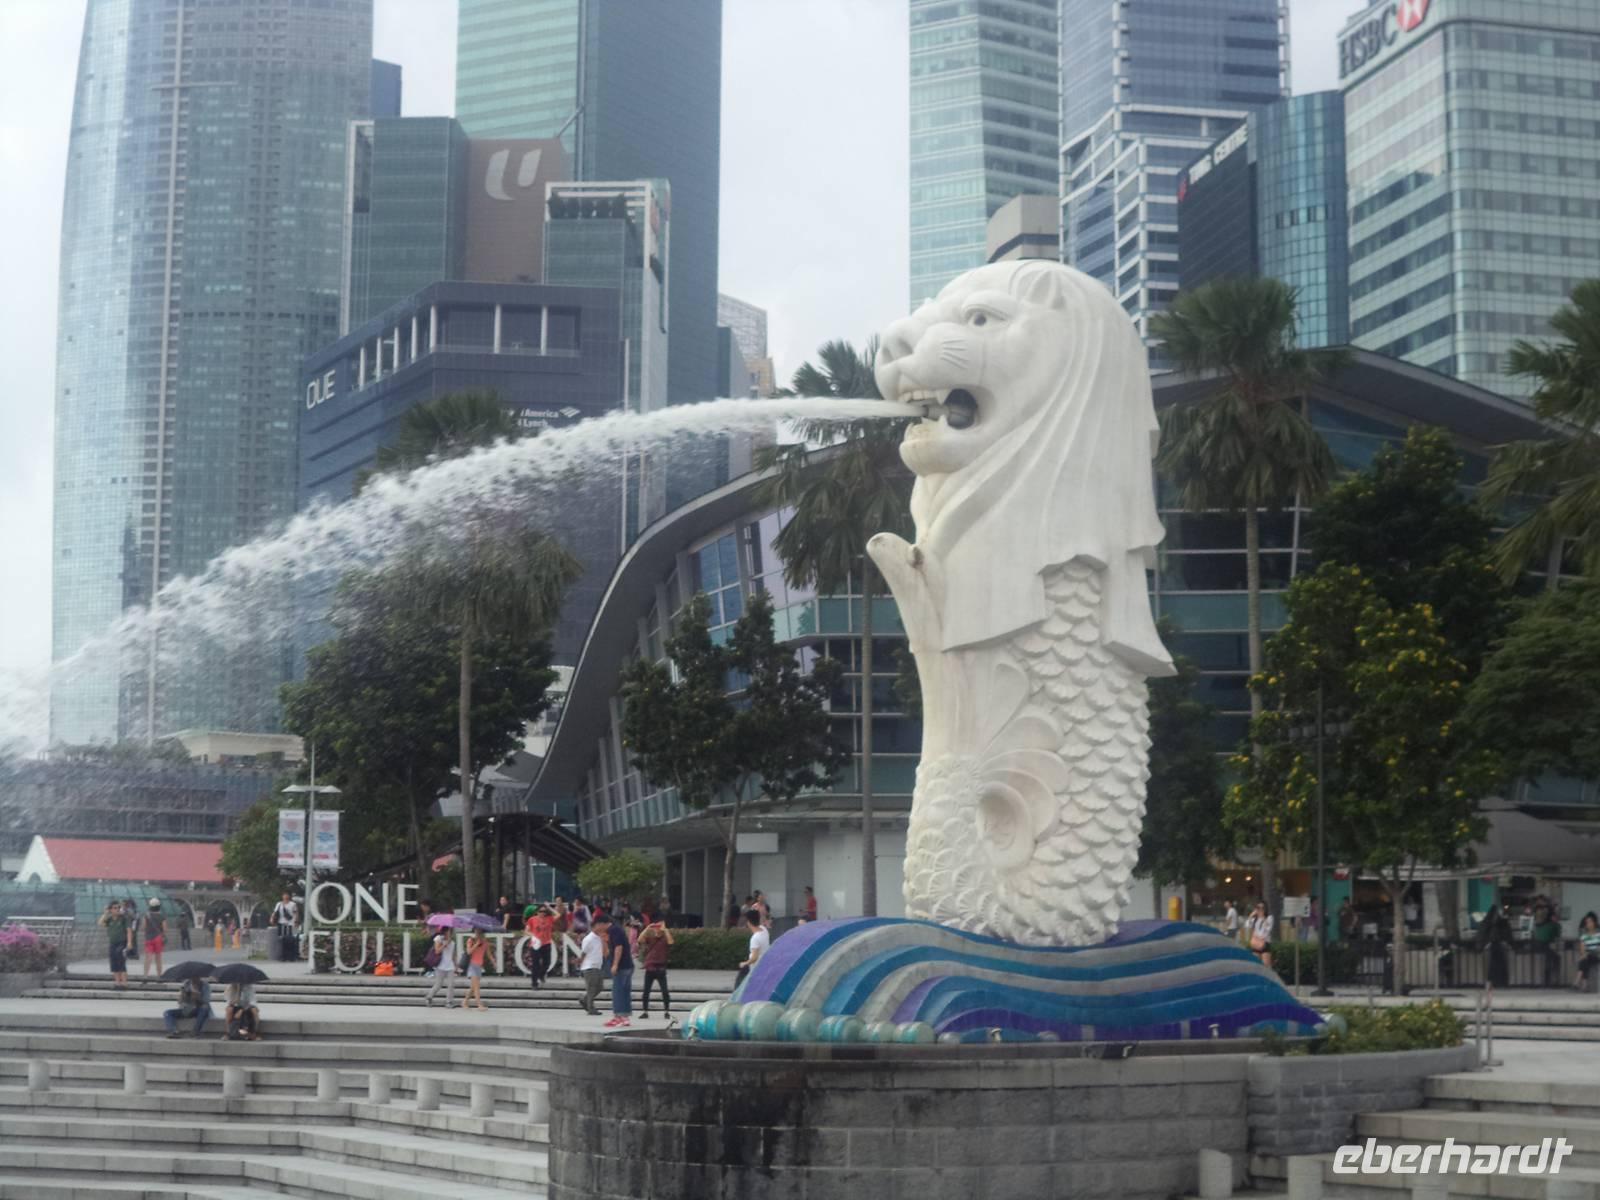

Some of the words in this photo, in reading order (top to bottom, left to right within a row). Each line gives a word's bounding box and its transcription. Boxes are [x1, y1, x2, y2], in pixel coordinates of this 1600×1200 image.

[1338, 3, 1399, 79] HSBC
[306, 369, 336, 410] OUE
[524, 408, 559, 418] America
[309, 881, 420, 925] ONE
